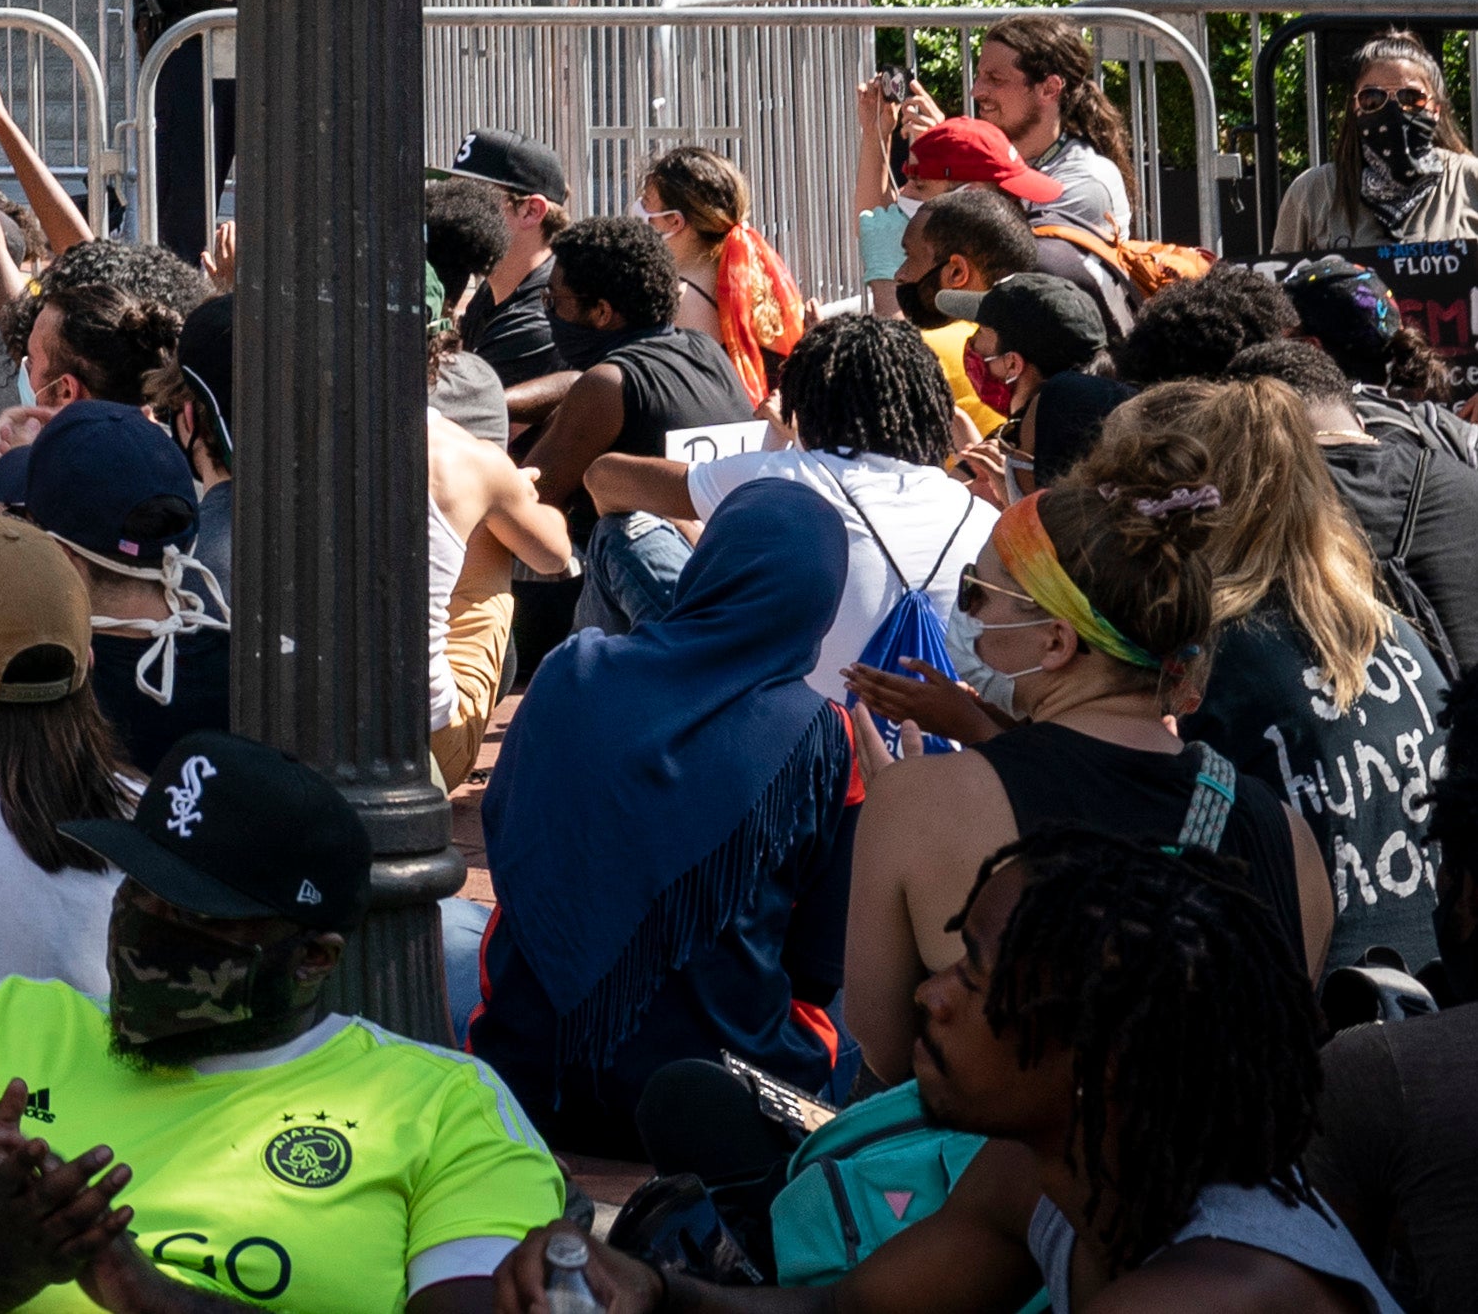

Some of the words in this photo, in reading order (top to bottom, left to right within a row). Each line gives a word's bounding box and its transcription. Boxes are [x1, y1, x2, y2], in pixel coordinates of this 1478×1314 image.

[456, 134, 477, 163] 3
[1394, 257, 1461, 274] FLOYD
[274, 1126, 314, 1150] AJAX
